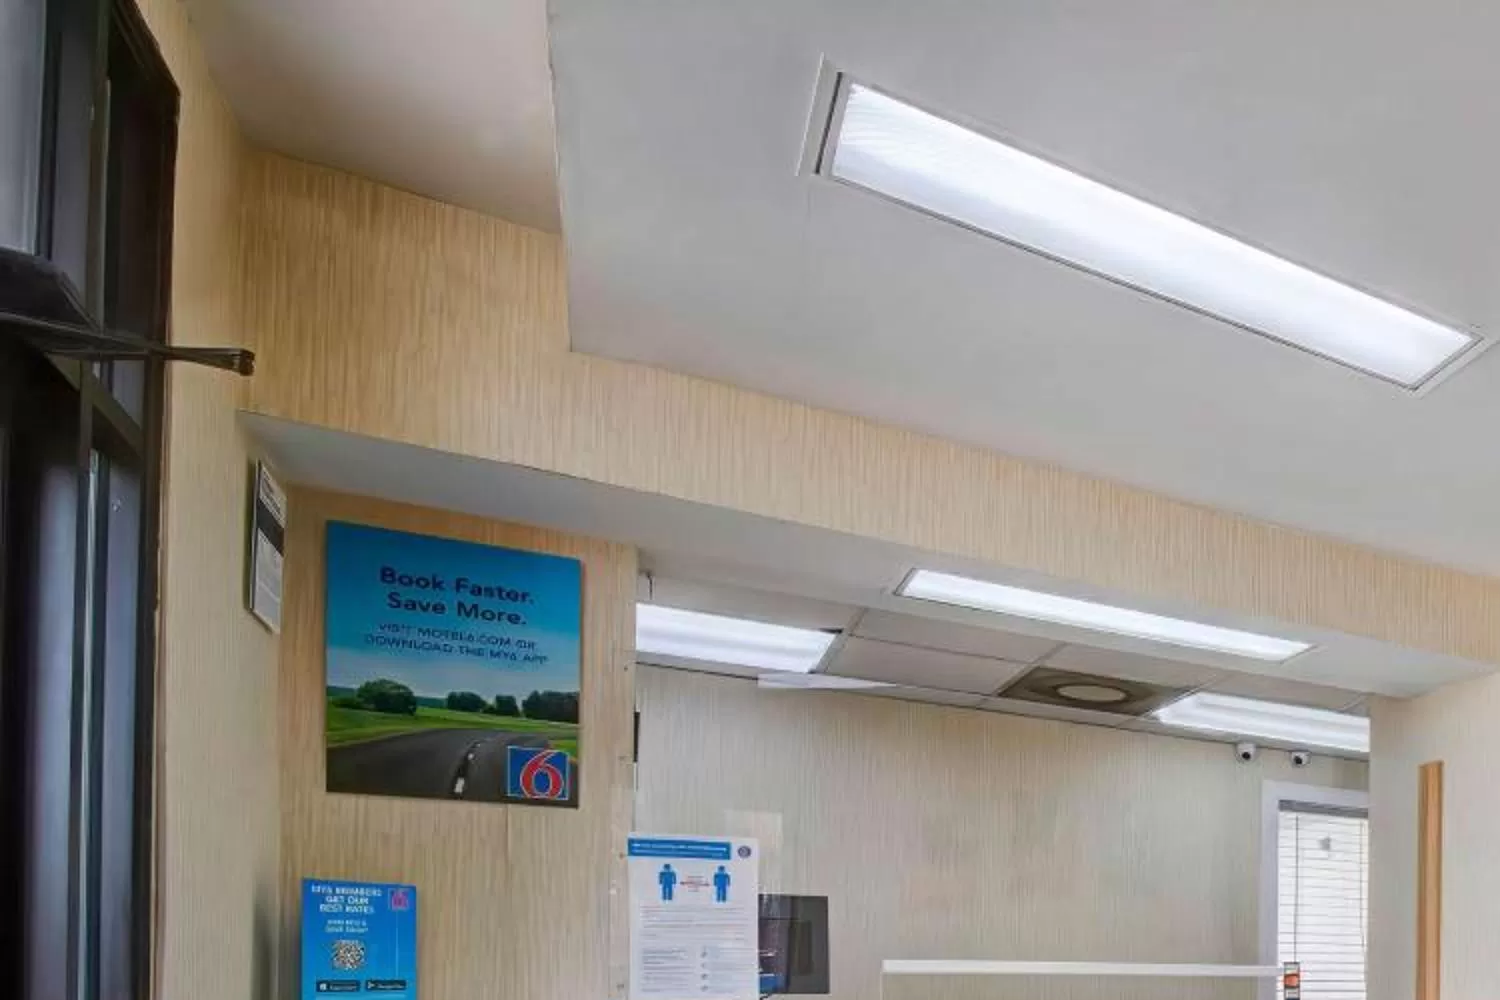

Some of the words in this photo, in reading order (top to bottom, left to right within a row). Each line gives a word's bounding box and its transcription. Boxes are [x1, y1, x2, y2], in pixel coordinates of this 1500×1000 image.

[380, 566, 446, 591] Book
[456, 577, 534, 604] Faster.
[387, 592, 446, 614] Save
[457, 602, 527, 626] More.
[365, 633, 452, 653] DOWNLOAD
[458, 645, 485, 657] THE
[523, 654, 548, 665] APP
[519, 749, 565, 800] 6
